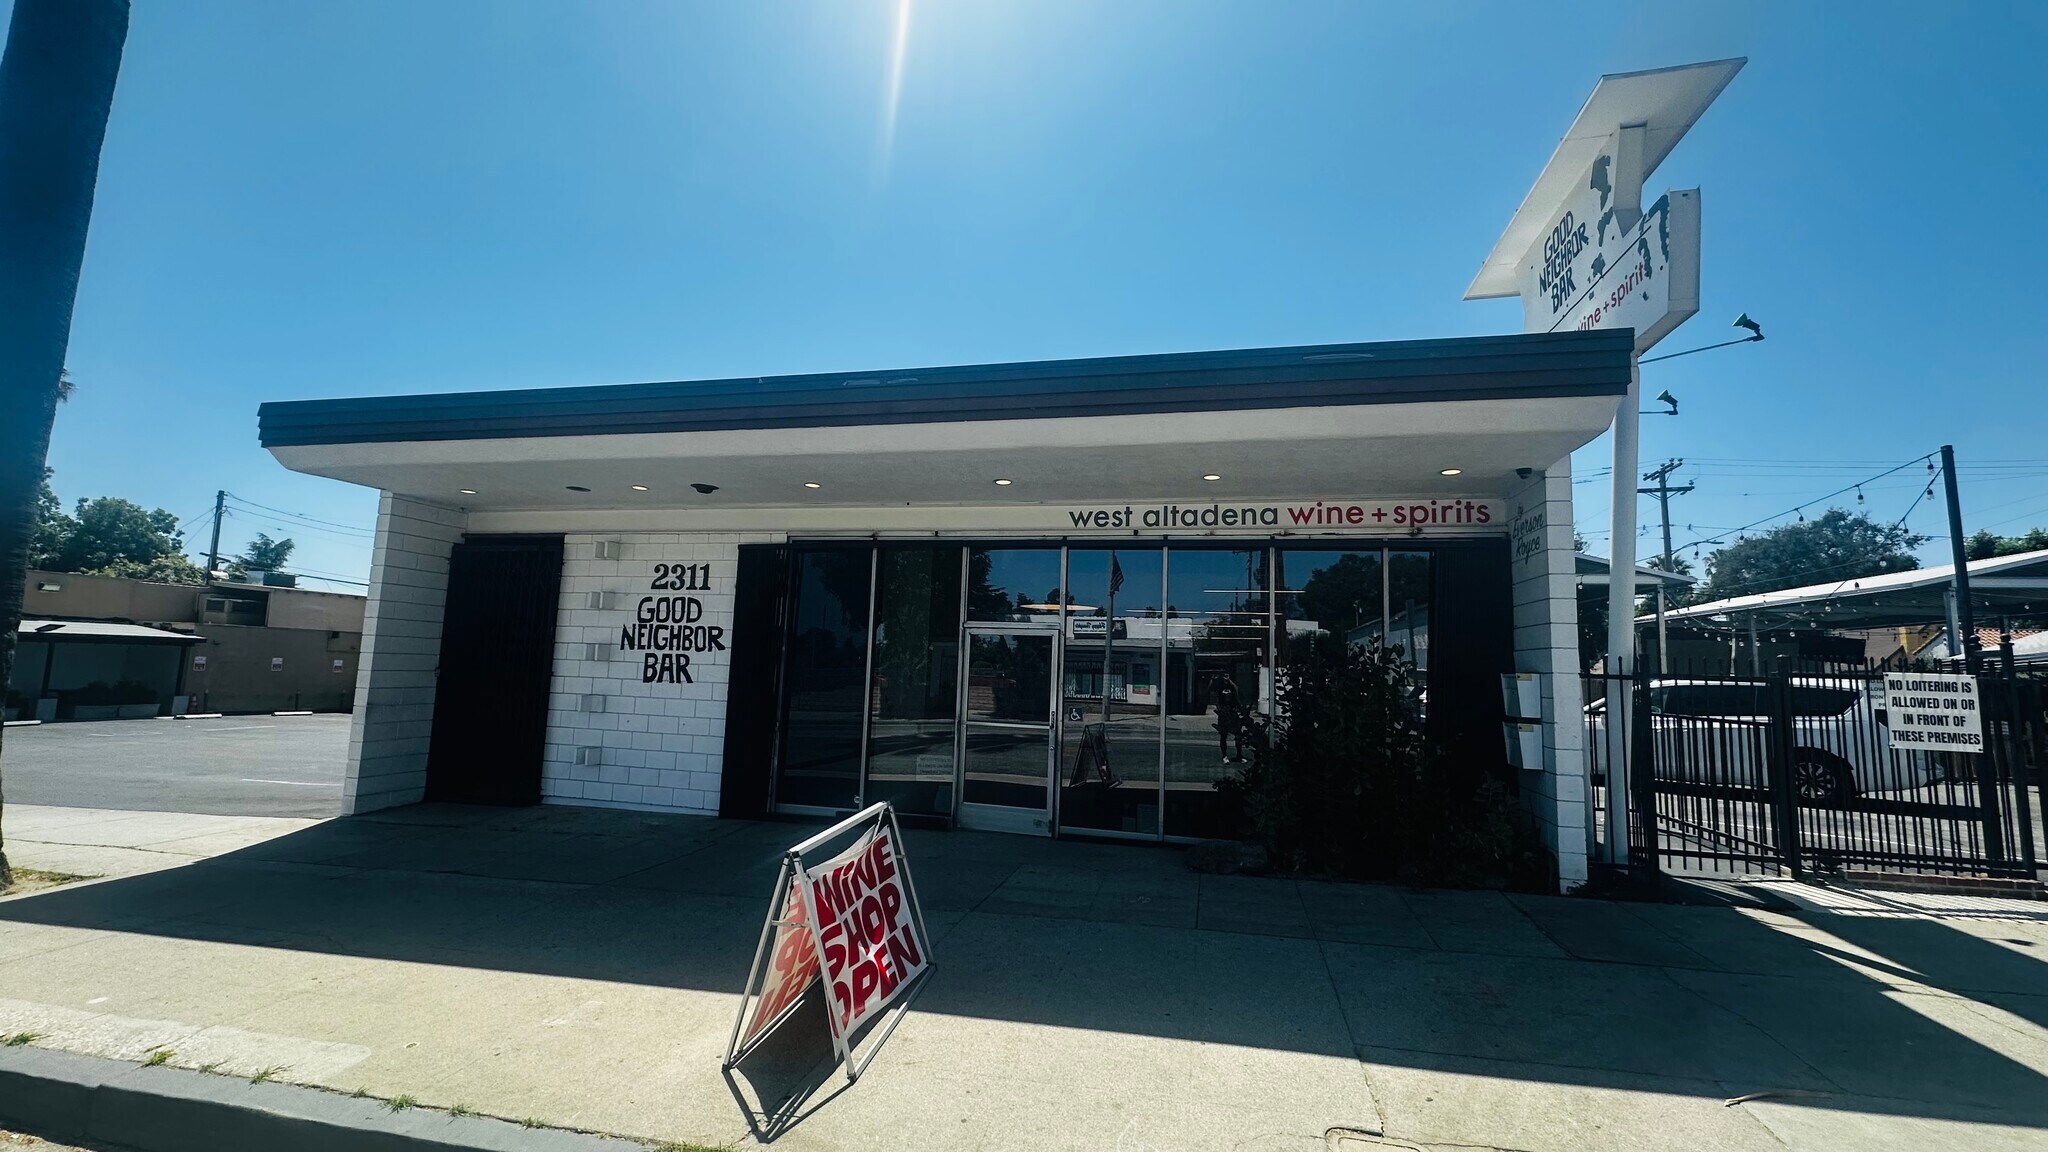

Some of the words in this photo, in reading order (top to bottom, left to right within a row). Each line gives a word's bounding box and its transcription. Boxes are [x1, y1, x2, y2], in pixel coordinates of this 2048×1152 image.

[1544, 210, 1573, 263] GOOD
[1539, 222, 1589, 297] NEIGHBOR
[1551, 266, 1576, 314] BAR
[1069, 506, 1133, 528] west
[1142, 505, 1278, 527] altadena
[1512, 512, 1544, 539] Everson
[1516, 536, 1541, 565] Royce
[651, 563, 711, 591] 2311
[637, 596, 702, 624] GOOD
[620, 623, 726, 652] NEIGHBOR
[642, 652, 694, 684] BAR
[1889, 680, 1903, 691] NO
[1906, 680, 1958, 693] LOITERING
[1961, 682, 1972, 693] IS
[1892, 696, 1940, 709] ALLOWED
[1943, 698, 1958, 710] ON
[1961, 699, 1976, 711] OR
[1903, 713, 1913, 725] IN
[1917, 714, 1950, 727] FRONT
[1953, 715, 1967, 727] OF
[1892, 730, 1925, 743] THESE
[1927, 731, 1981, 745] PREMISES
[821, 882, 901, 982] SHOP
